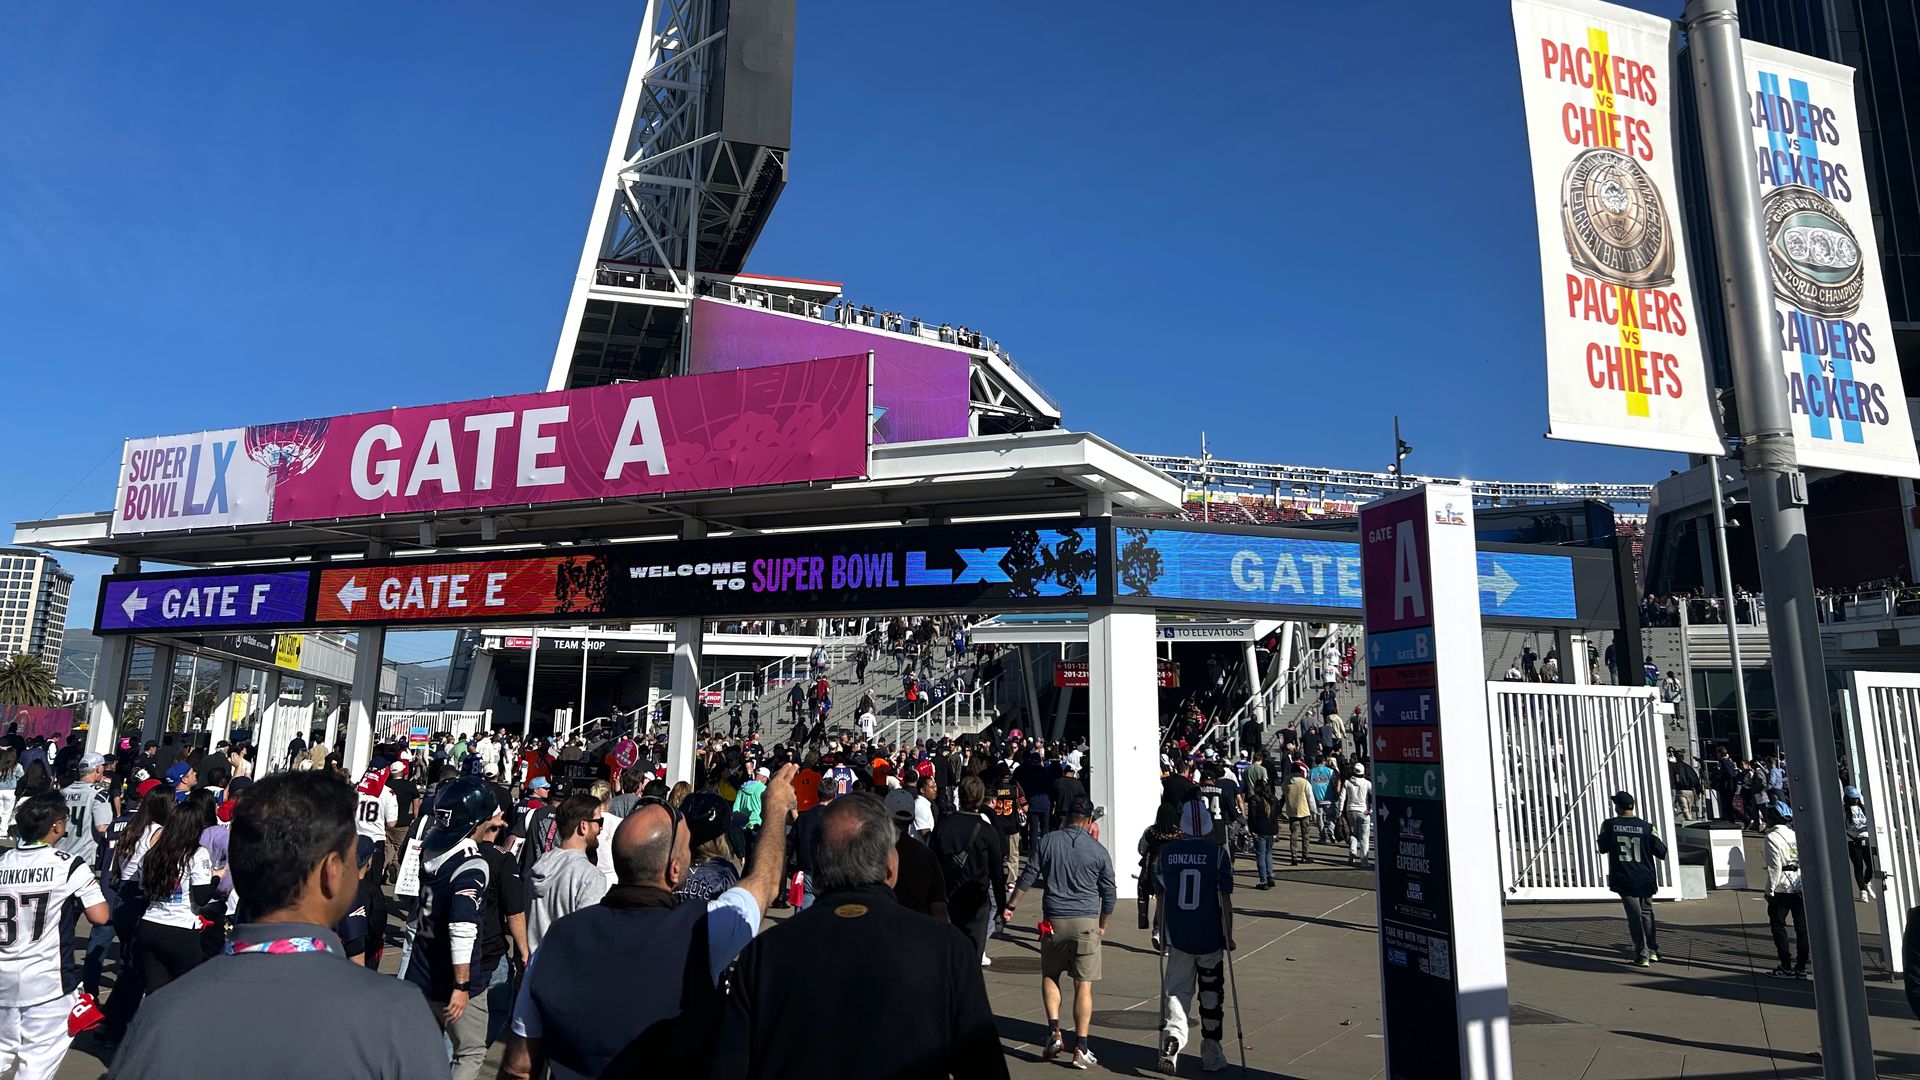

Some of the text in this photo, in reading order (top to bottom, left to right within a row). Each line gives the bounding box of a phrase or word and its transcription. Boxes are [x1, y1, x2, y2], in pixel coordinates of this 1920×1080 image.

[1541, 38, 1657, 106] PACKERS
[1596, 93, 1614, 109] VS
[1562, 102, 1654, 162] CHIEFS
[1785, 136, 1801, 151] VS
[1756, 146, 1852, 203] ACKERS
[1773, 200, 1798, 222] GREEN
[1573, 211, 1601, 257] GREEN
[1602, 244, 1624, 271] BAY
[1784, 267, 1861, 302] WORLD CHAMPIONS
[1566, 273, 1687, 336] PACKERS
[1621, 329, 1640, 345] VS
[1586, 342, 1683, 399] CHIEFS
[1818, 359, 1835, 373] VS
[1784, 372, 1889, 426] ACKERS
[350, 396, 670, 501] GATE A
[129, 446, 187, 483] SUPER
[182, 440, 237, 517] LX
[123, 482, 179, 521] BOWL
[629, 561, 747, 580] WELCOME
[713, 578, 746, 591] TO
[752, 546, 1015, 593] SUPER BOWL LX
[1229, 549, 1363, 598] GATE
[1369, 519, 1426, 621] GATE A
[162, 583, 271, 619] GATE F
[378, 572, 508, 611] GATE E
[554, 640, 606, 650] TEAM SHOP
[1177, 627, 1245, 638] TO ELEVATORS
[1397, 633, 1428, 661] GATE B
[1400, 694, 1430, 720] GATE F
[1402, 732, 1433, 758] GATE E
[1404, 769, 1436, 797] GATE C
[359, 800, 380, 823] 18
[1168, 853, 1208, 865] GONZALEZ
[1396, 855, 1431, 874] EXPERIENCE
[1399, 841, 1426, 858] GAMEDAY
[1616, 835, 1641, 863] 31
[1178, 868, 1202, 911] 0
